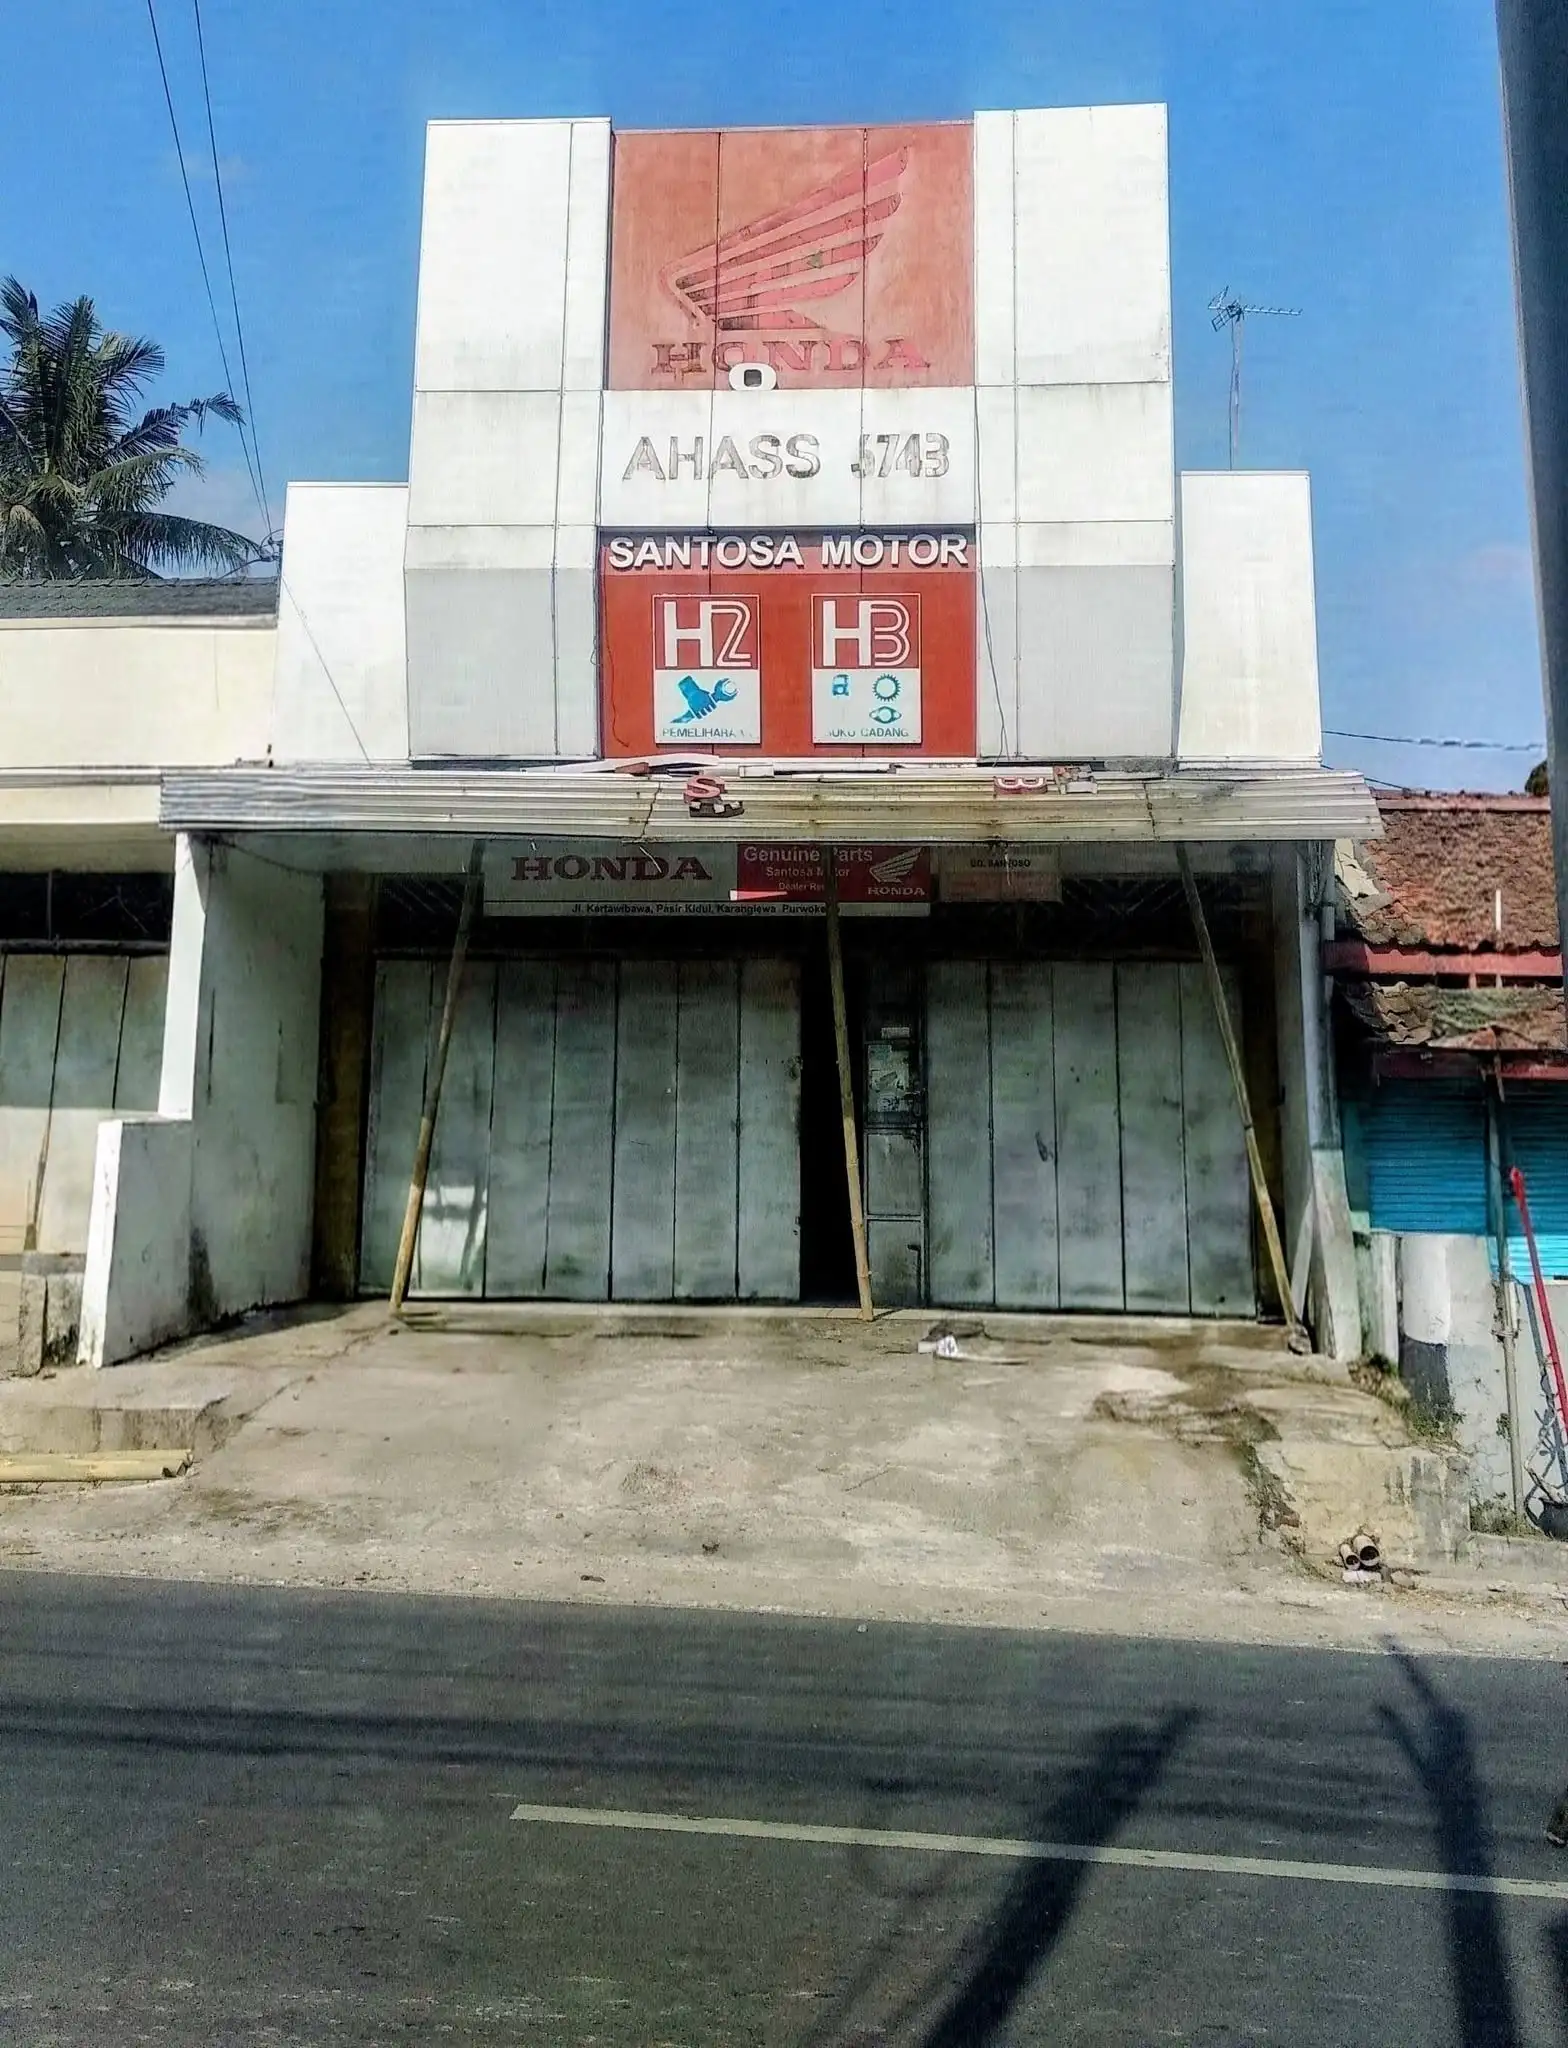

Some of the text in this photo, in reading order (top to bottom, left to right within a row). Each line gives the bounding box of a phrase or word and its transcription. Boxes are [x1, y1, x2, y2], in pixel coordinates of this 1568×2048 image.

[651, 337, 931, 374] HONDA
[622, 434, 821, 480] AHASS
[609, 534, 969, 570] SANTOSA MOTOR
[822, 600, 910, 667] H3
[662, 727, 753, 738] PEMELIHARA
[743, 846, 821, 862] Genuine
[510, 855, 712, 881] HONDA
[765, 866, 814, 878] Santosa
[867, 887, 927, 896] HONDA
[656, 903, 682, 913] Pasir
